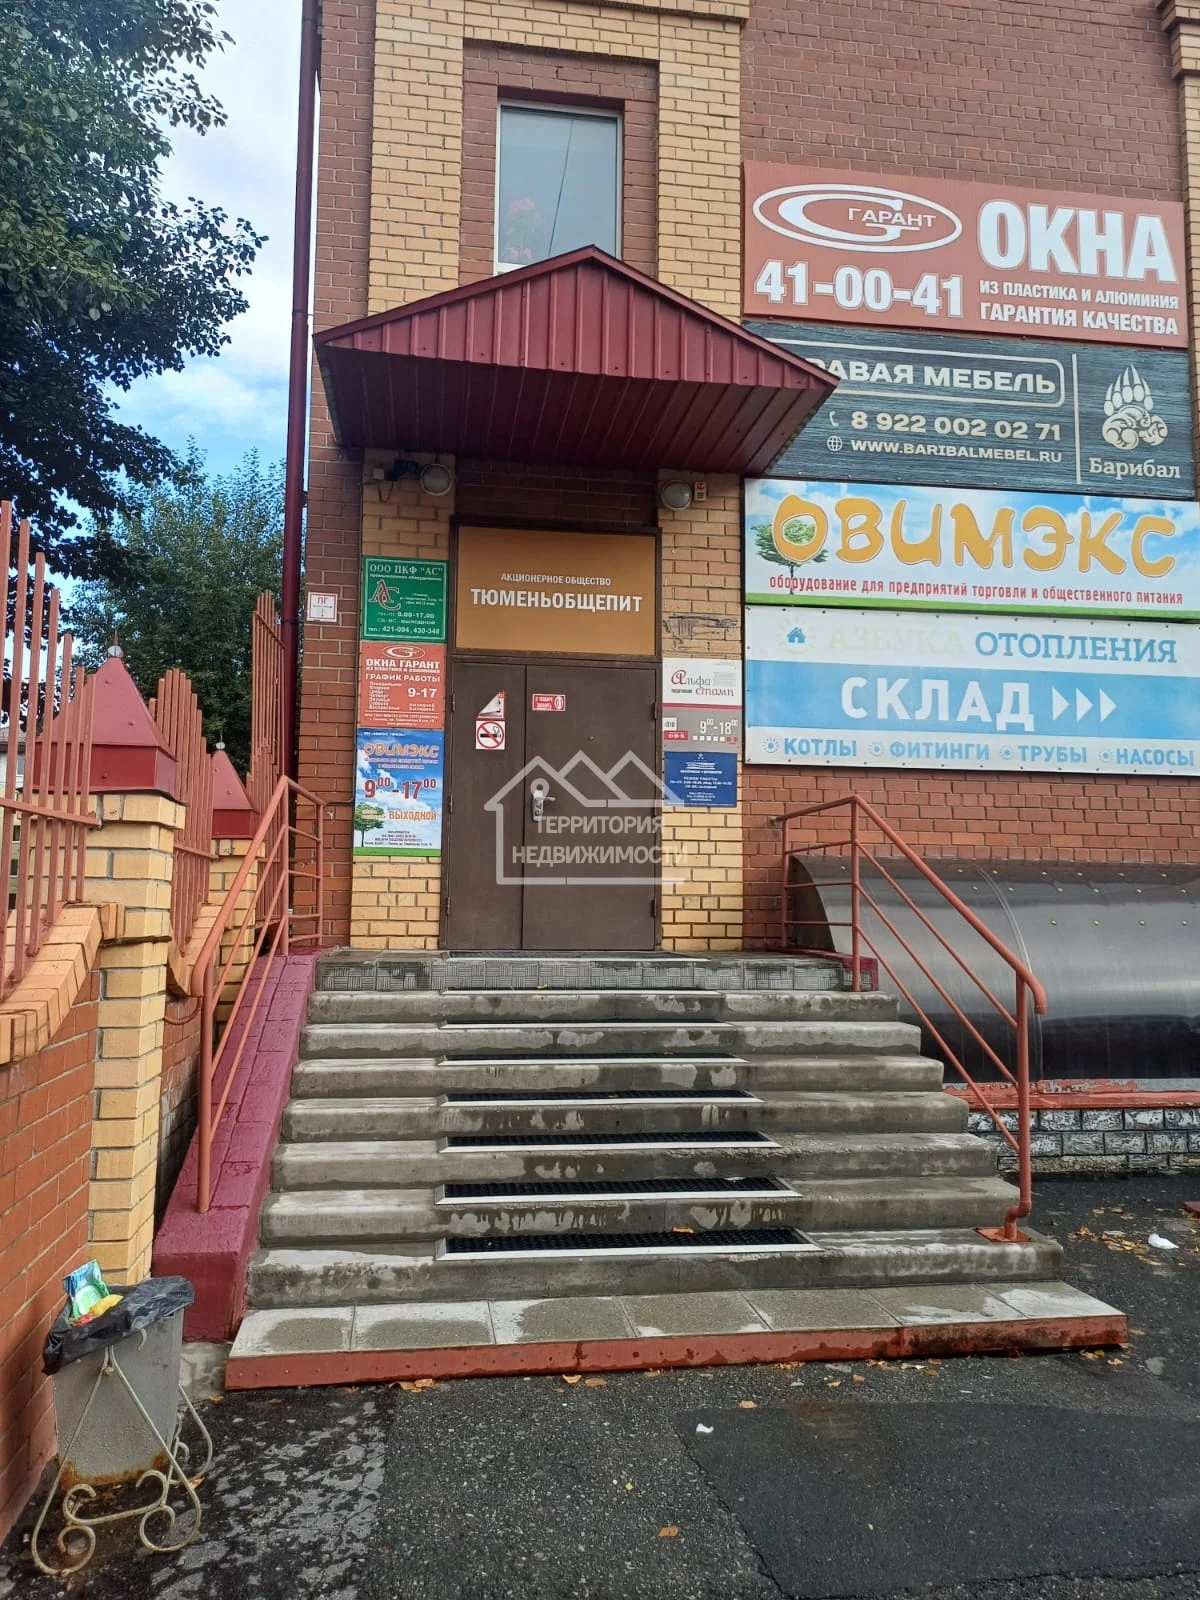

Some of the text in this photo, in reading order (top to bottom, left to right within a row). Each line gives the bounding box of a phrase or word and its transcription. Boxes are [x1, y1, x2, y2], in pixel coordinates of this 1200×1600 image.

[848, 207, 936, 228] ГАРАНТ
[978, 199, 1179, 283] ОКНА
[754, 260, 964, 319] 41-00-41
[979, 280, 1179, 309] ИЗ ПЛАСТИКА И АЛЮМИНИЯ
[980, 302, 1179, 335] ГАРАНТИЯ КАЧЕСТВА
[924, 366, 1056, 394] МЕБЕЛЬ
[851, 411, 1062, 441] 8 922 002 02 71
[851, 439, 1062, 463] WWW.BARIBALMEBEL.RU
[1089, 457, 1181, 480] Барибал
[771, 494, 1177, 578] ОВИМЭКС
[370, 564, 391, 572] ООО
[395, 565, 417, 574] ПКФ
[501, 572, 612, 587] АКЦИОНЕРНОЕ ОБЩЕСТВО
[471, 588, 643, 613] ТЮМЕНЬОБЩЕПИТ
[769, 575, 1183, 604] оборудование для предприятий торговли и общественного питания
[975, 631, 1177, 663] ОТОПЛЕНИЯ
[366, 659, 440, 669] ОКНА ГАРАНТ
[407, 687, 437, 698] 9-17
[841, 677, 1035, 732] СКЛАД
[784, 738, 1195, 767] КОТЛЫ ФИТИНГИ ТРУБЫ НАСОСЫ
